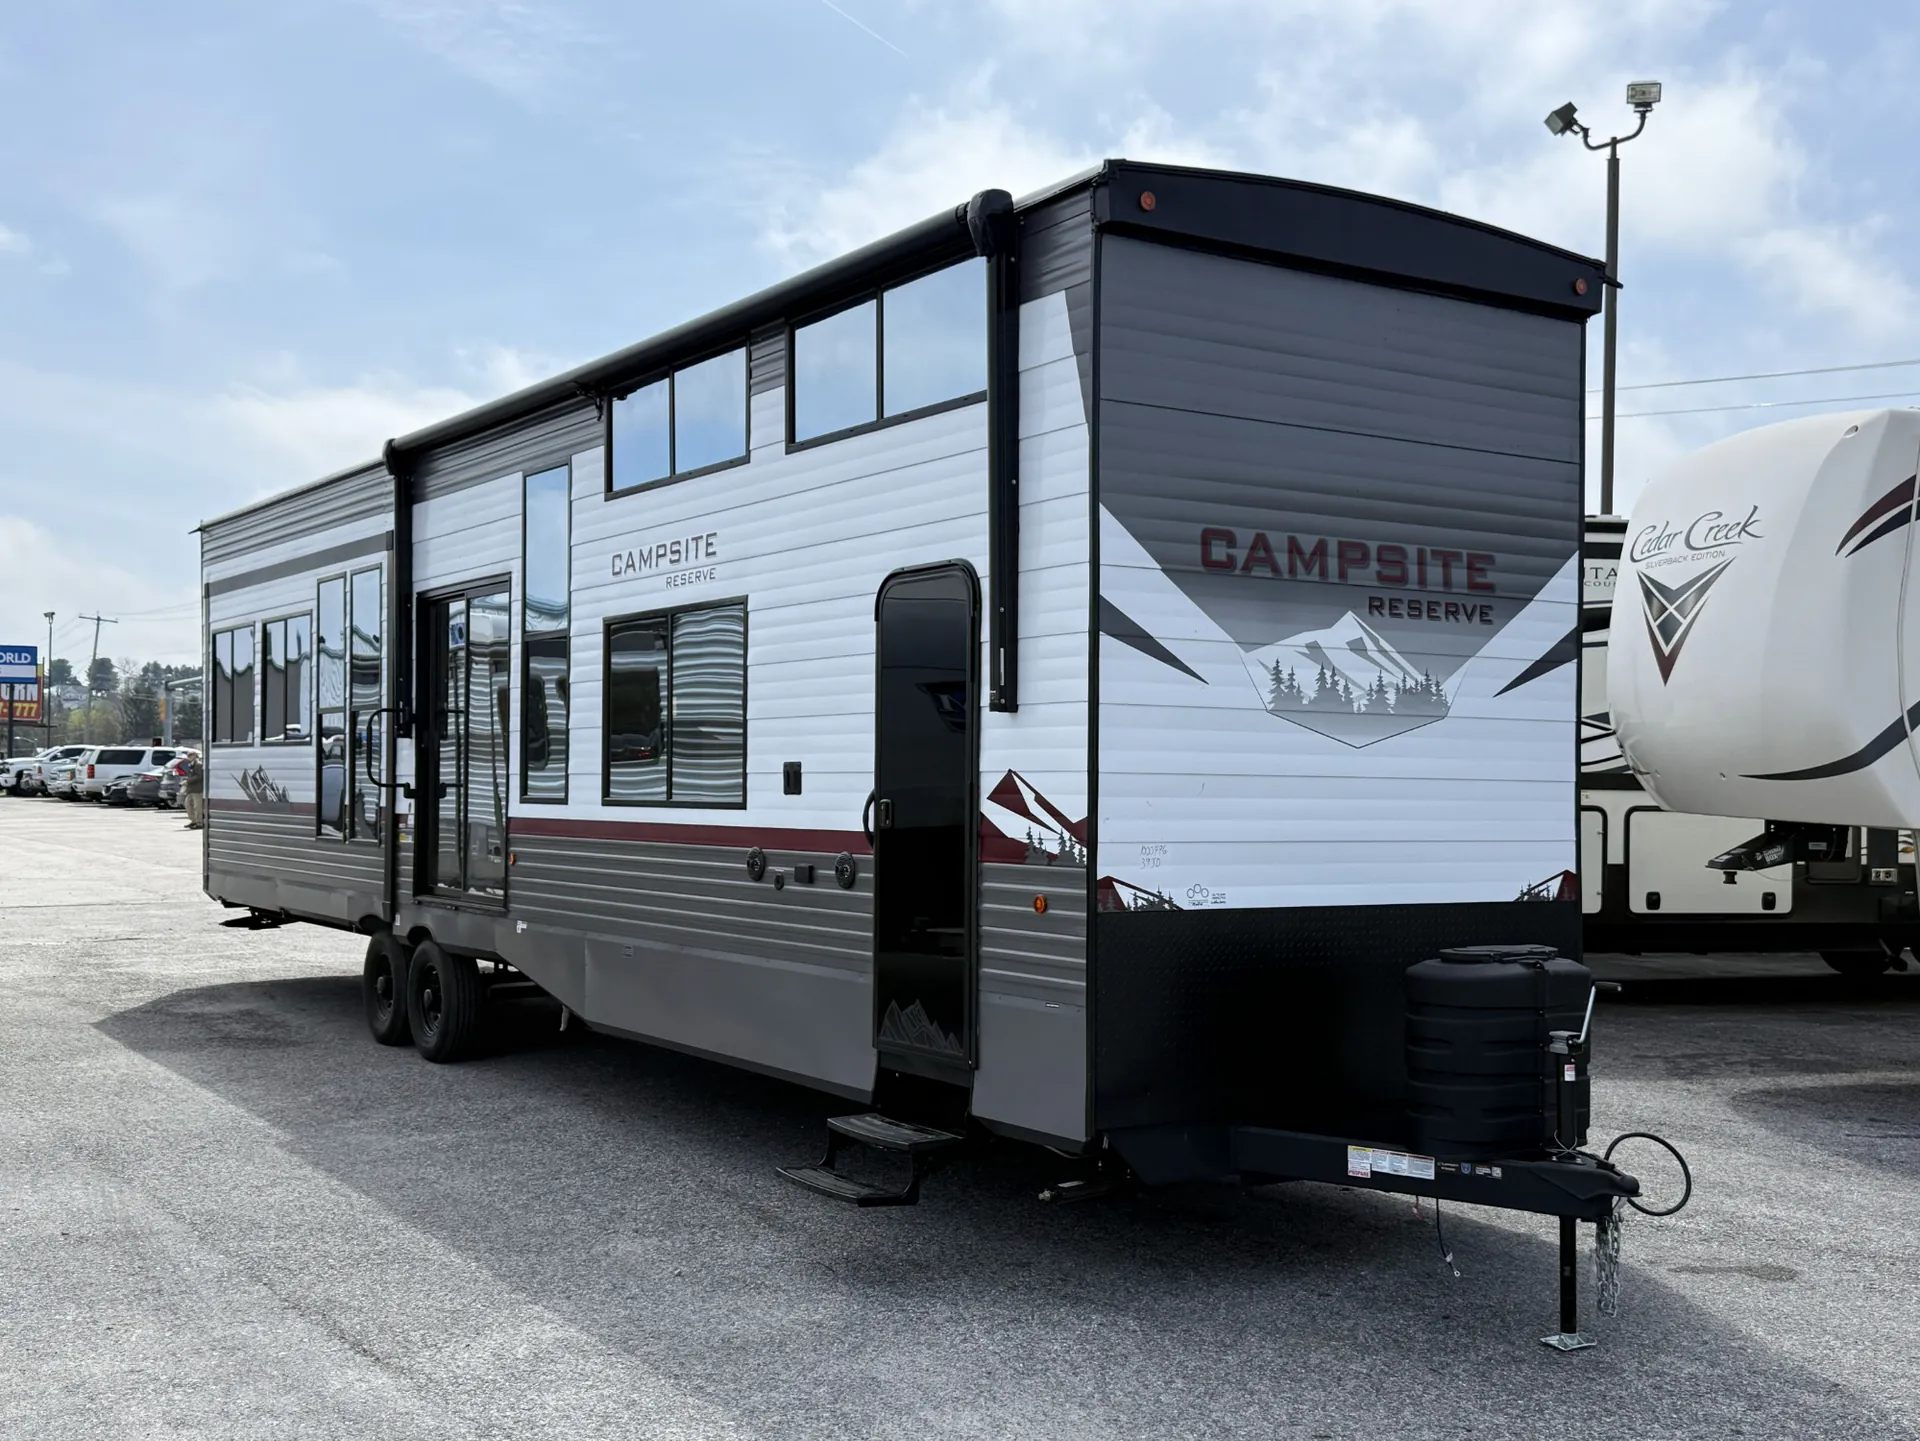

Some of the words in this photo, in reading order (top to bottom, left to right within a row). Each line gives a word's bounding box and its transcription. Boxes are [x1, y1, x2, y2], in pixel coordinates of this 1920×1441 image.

[1629, 521, 1683, 563] Cedar
[1684, 504, 1765, 550] Creek
[611, 532, 718, 576] CAMPSITE
[1200, 526, 1497, 593] CAMPSITE
[1645, 555, 1688, 569] SILVERBACK
[1691, 550, 1725, 561] EDITION
[665, 567, 717, 589] RESERVE
[1368, 596, 1495, 626] RESERVE
